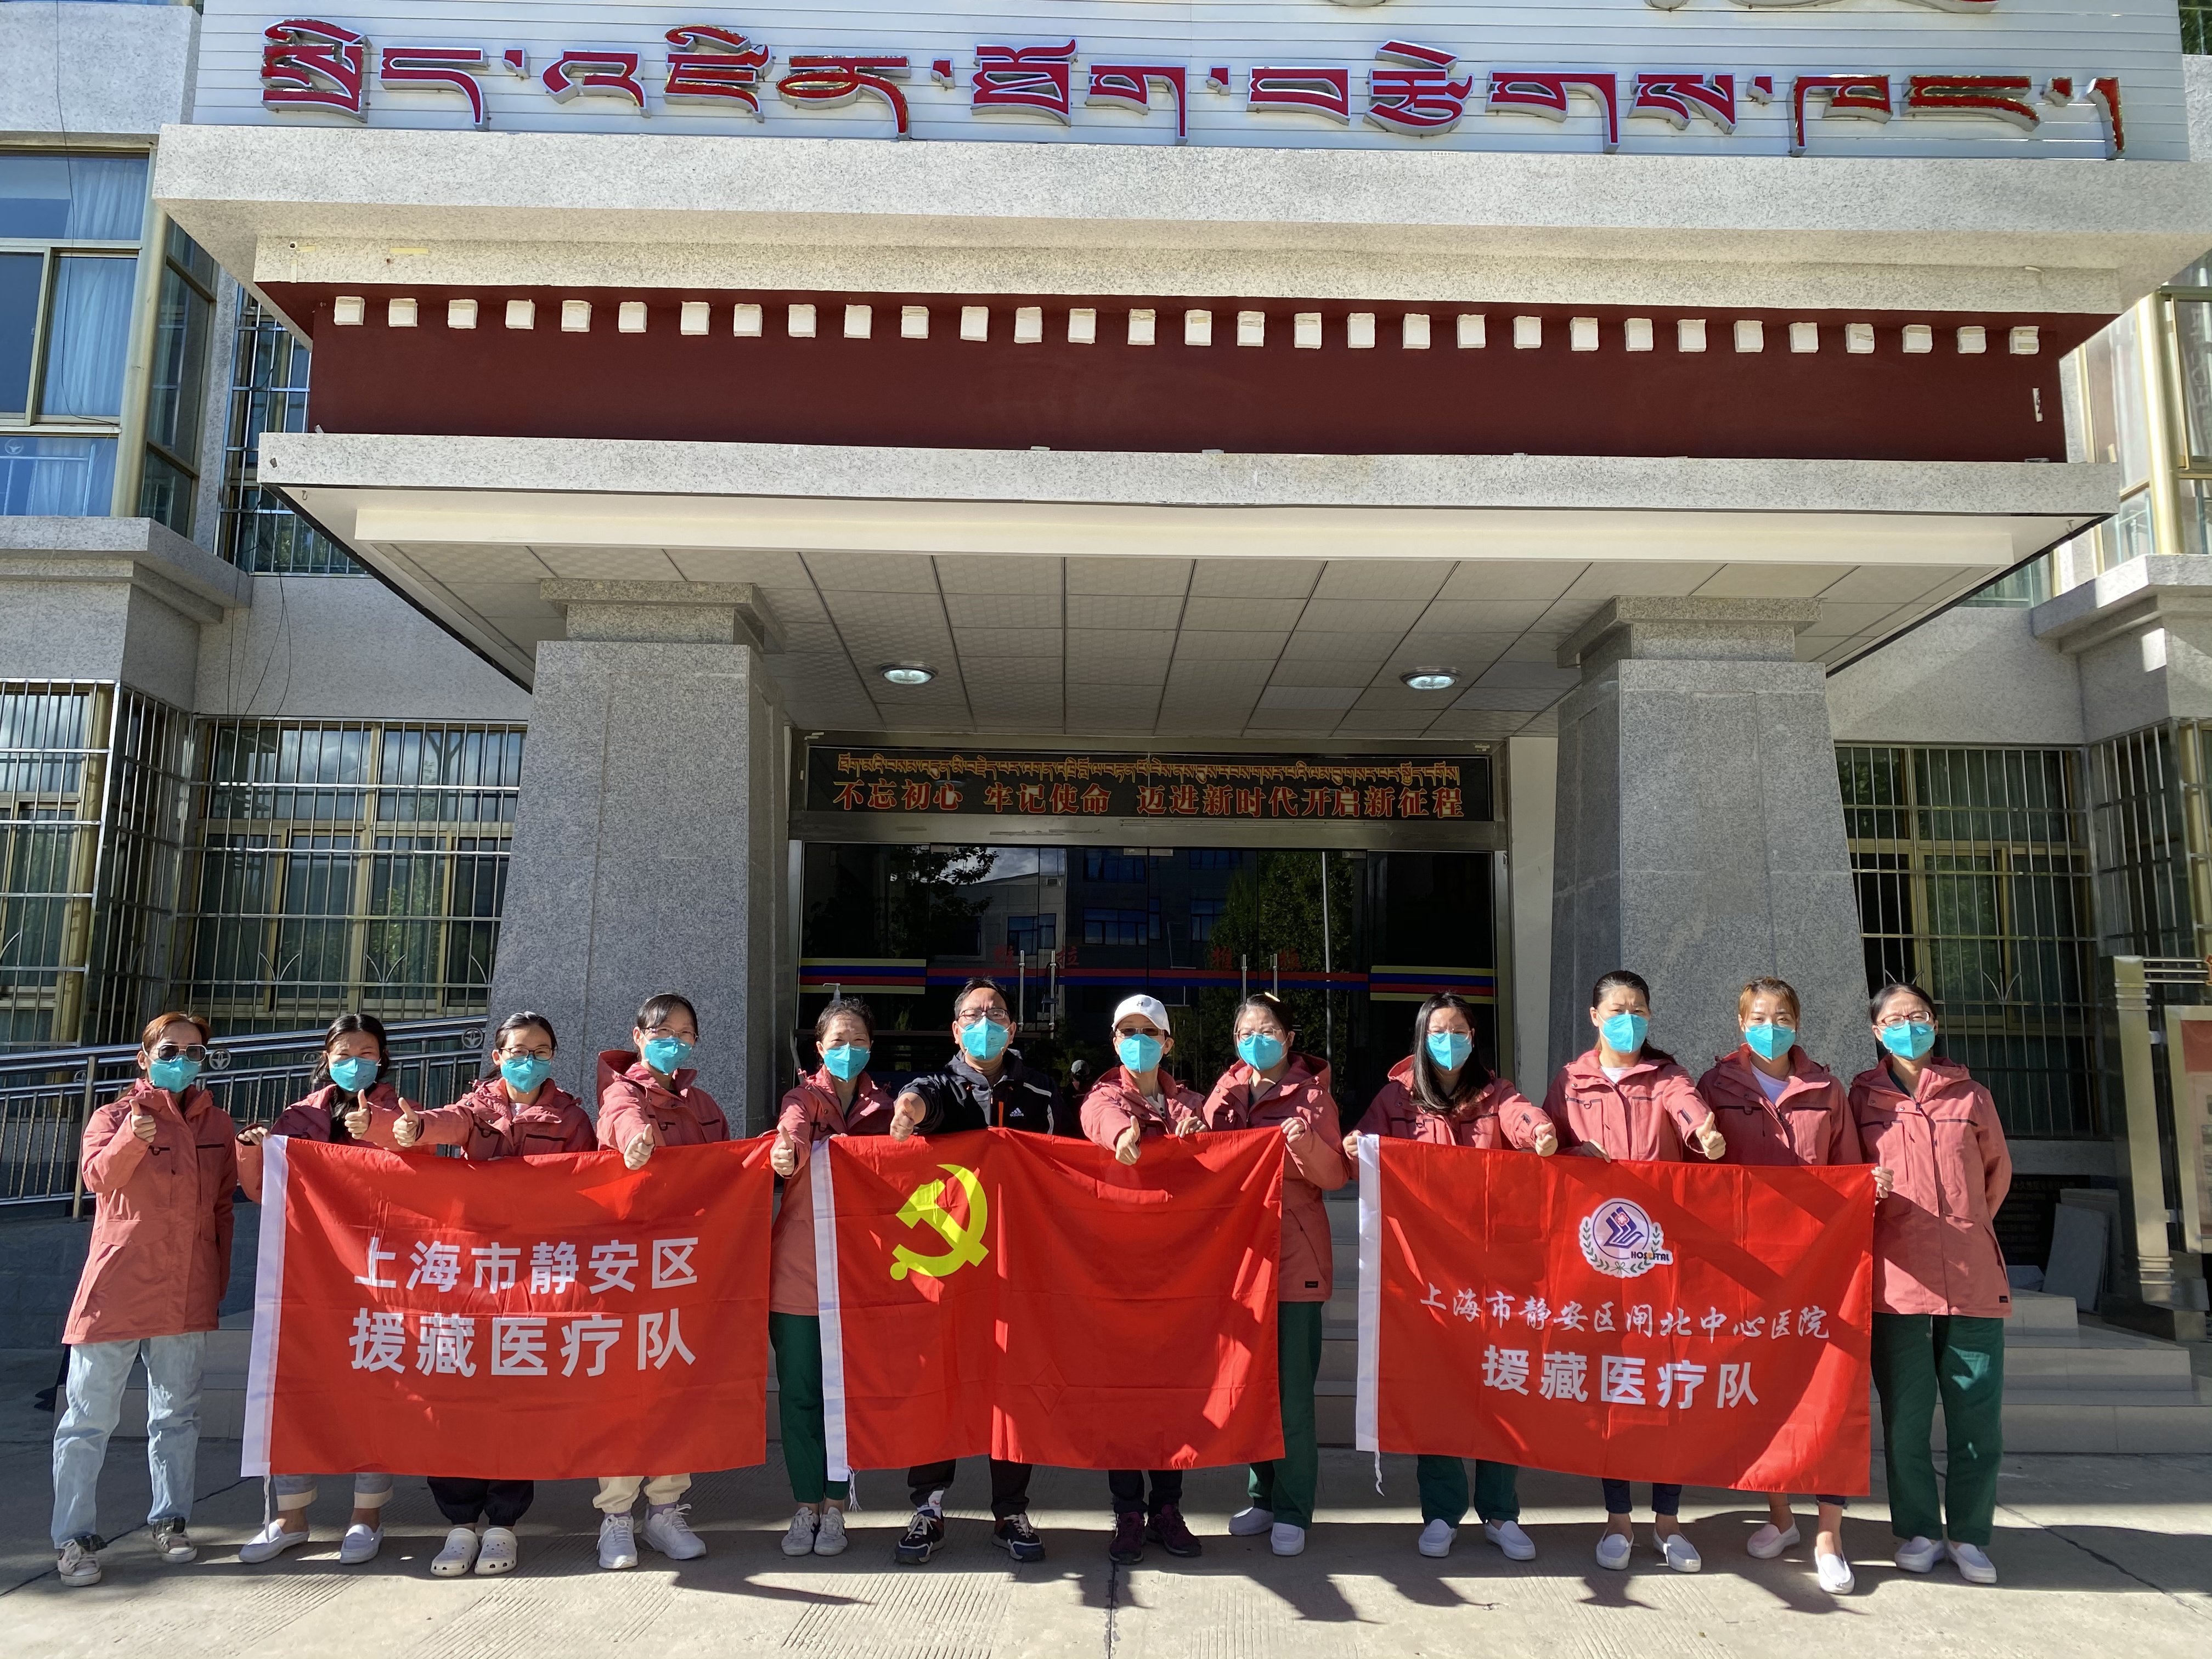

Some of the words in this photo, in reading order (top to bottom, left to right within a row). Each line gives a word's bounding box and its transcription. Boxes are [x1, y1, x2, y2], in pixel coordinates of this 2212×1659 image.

[833, 778, 963, 811] 不忘初心
[983, 782, 1111, 814] 牢记使命
[1136, 783, 1465, 817] 迈进新时代开启新征程
[1056, 944, 1080, 967] 拉
[354, 1236, 699, 1295] 上海市静安区
[348, 1307, 697, 1379] 援藏医疗队
[1420, 1281, 1830, 1344] 上海市静安区闸北中心医院
[1481, 1344, 1759, 1410] 援藏医疗队
